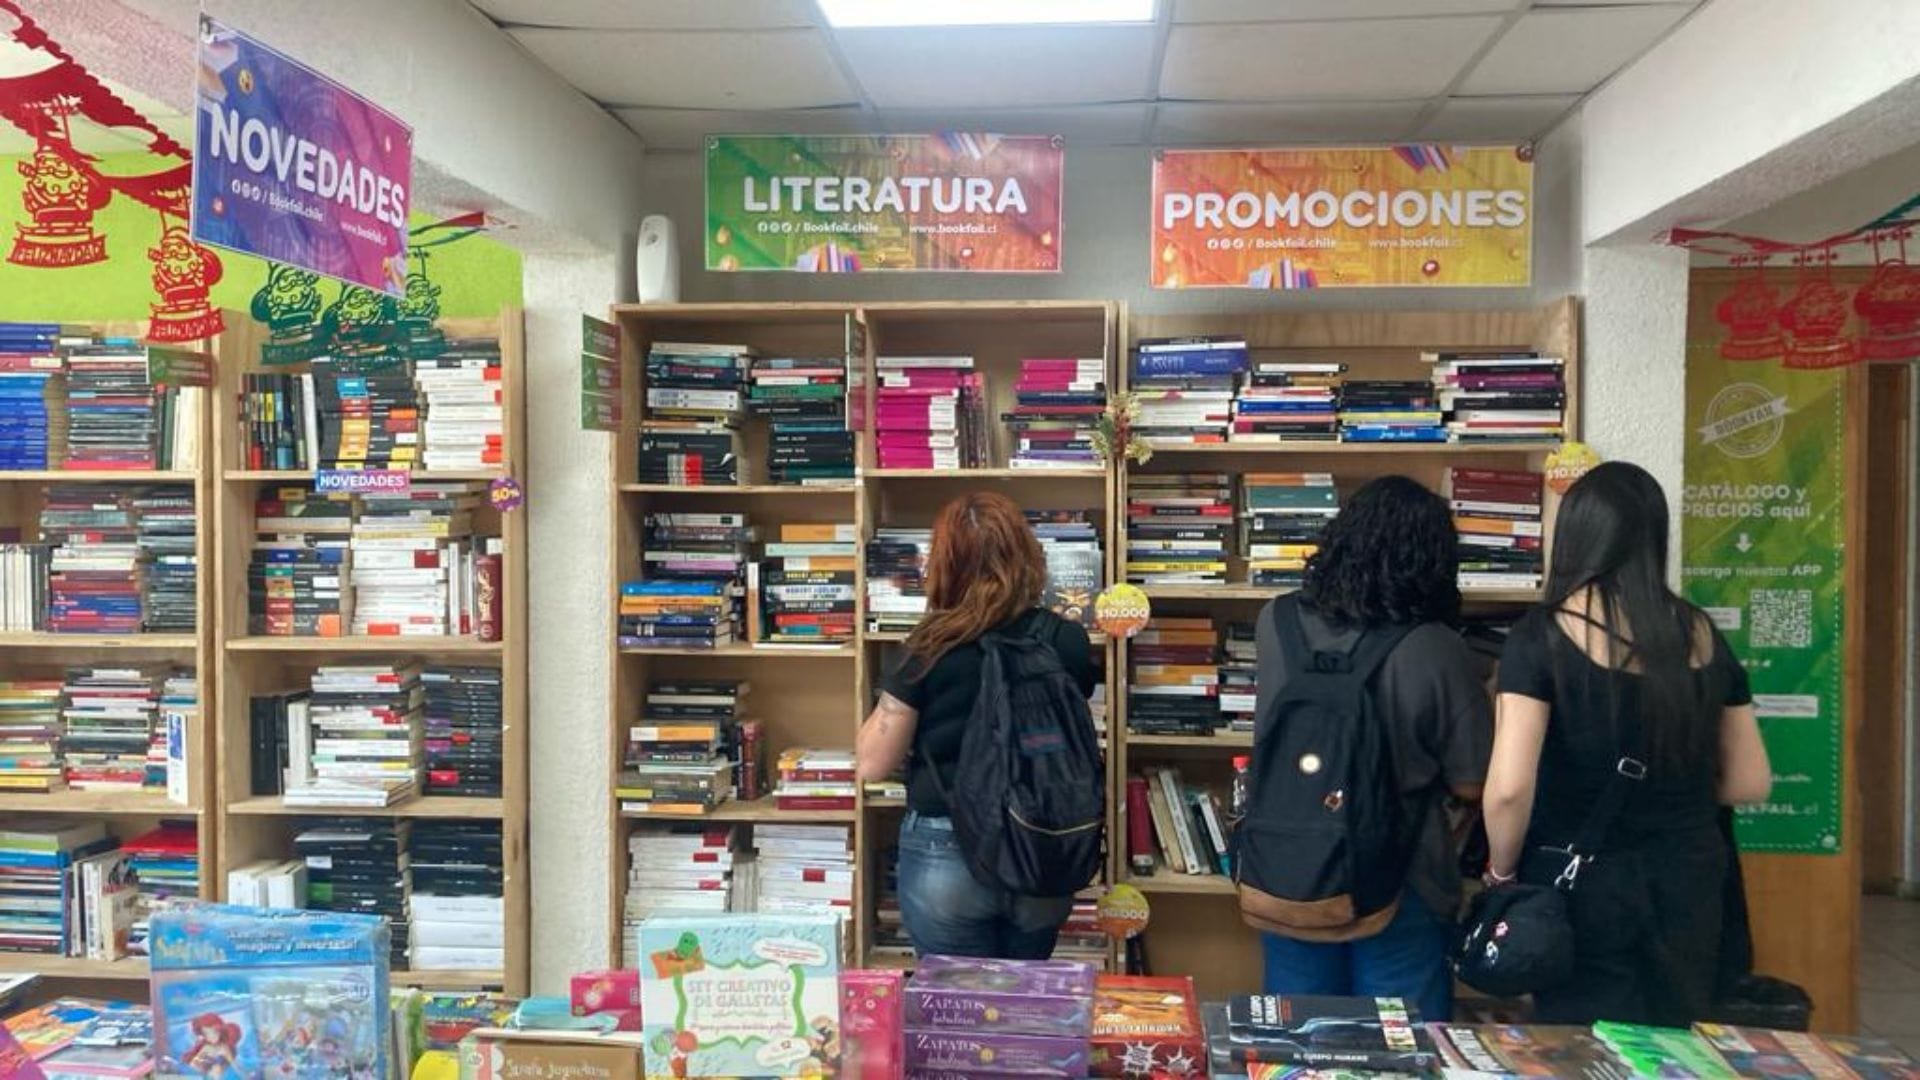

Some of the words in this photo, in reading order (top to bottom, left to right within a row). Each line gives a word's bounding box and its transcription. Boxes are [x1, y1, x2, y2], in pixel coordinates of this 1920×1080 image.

[210, 104, 405, 229] NOVEDADES
[742, 176, 1028, 214] LITERATURA
[1163, 190, 1527, 230] PROMOCIONES
[320, 475, 405, 487] NOVEDADES
[1795, 488, 1807, 503] y
[1681, 502, 1764, 518] PRECIOS
[1769, 502, 1811, 521] aquí
[1682, 567, 1732, 579] escarga
[1791, 563, 1822, 577] APP
